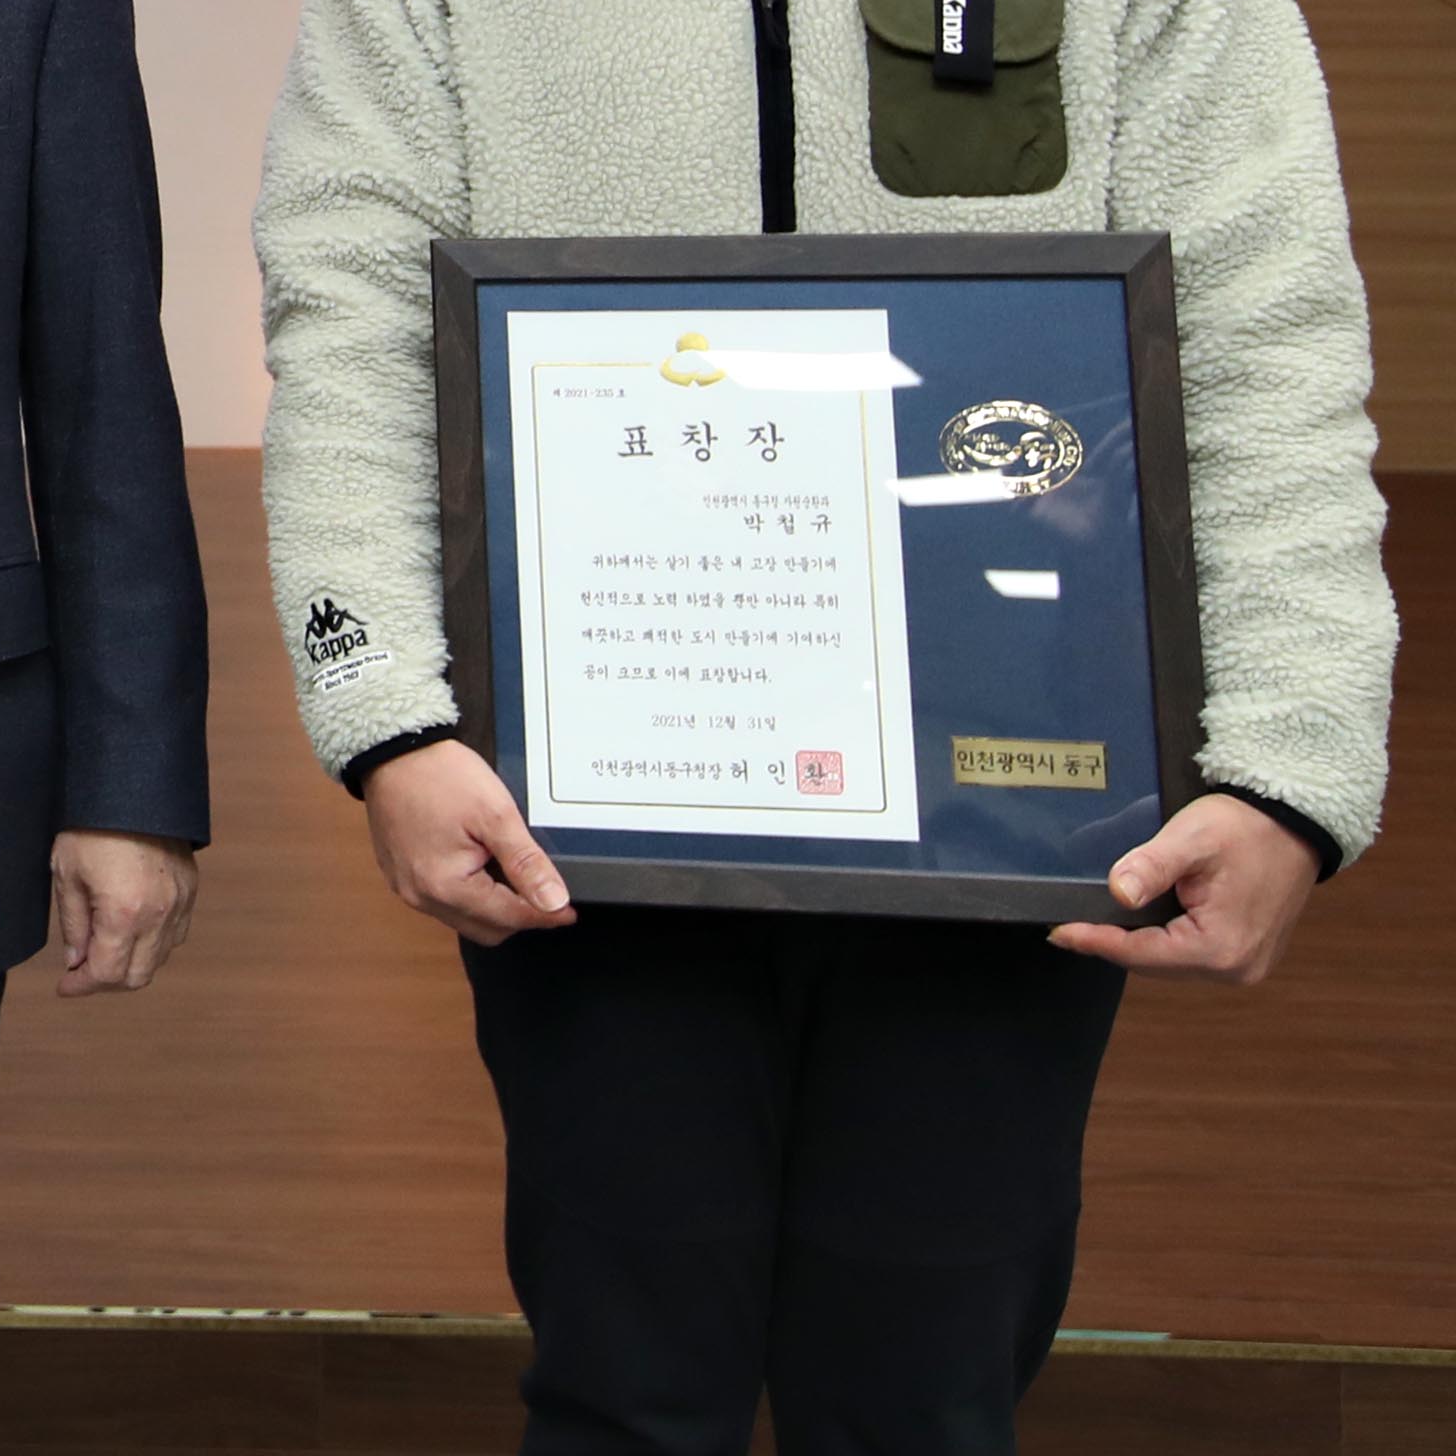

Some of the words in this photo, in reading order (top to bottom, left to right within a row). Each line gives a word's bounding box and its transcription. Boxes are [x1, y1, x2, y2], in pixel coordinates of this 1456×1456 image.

[651, 713, 696, 729] 2021년
[957, 749, 1055, 775] 인천광역시
[1064, 754, 1102, 777] 동구
